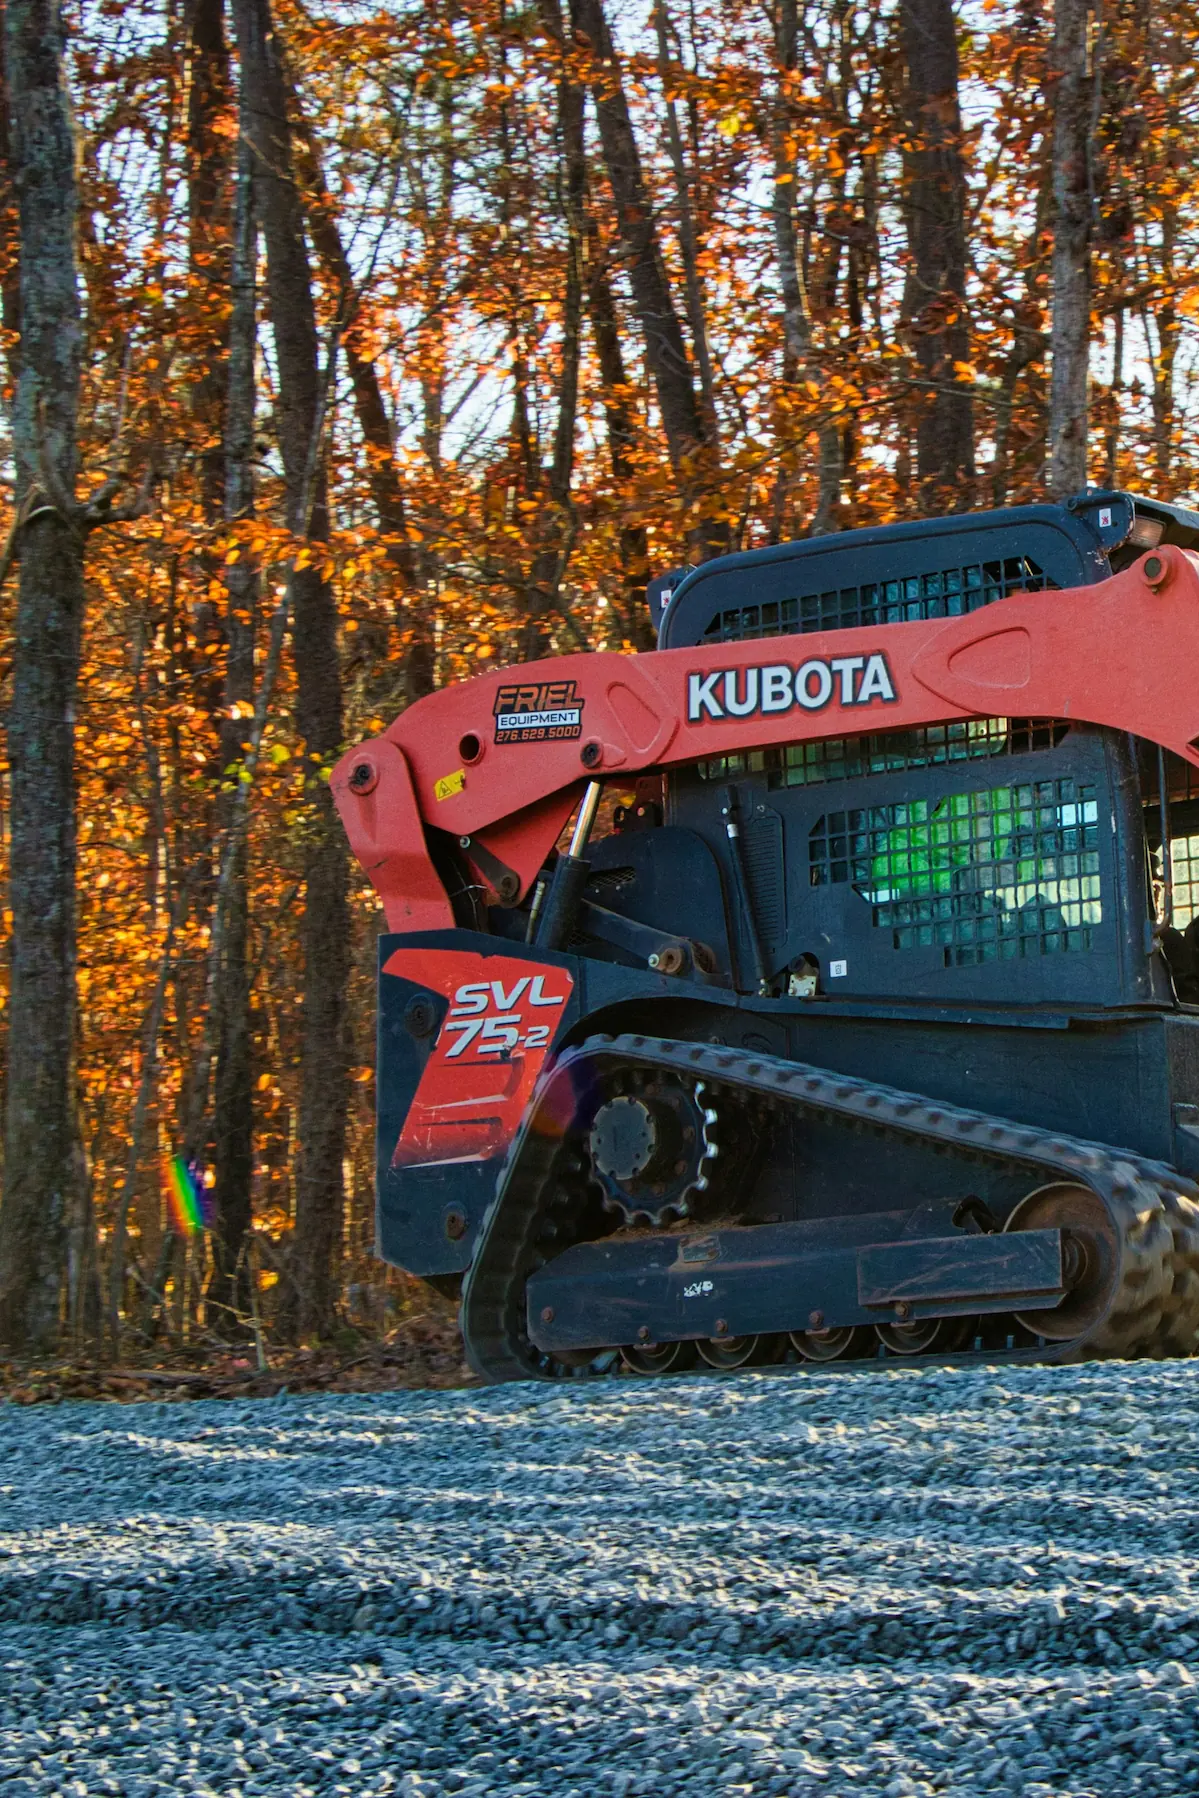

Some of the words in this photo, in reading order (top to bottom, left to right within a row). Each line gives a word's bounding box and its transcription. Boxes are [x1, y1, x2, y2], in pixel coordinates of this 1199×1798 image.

[495, 684, 583, 713] FRIEL
[688, 654, 895, 720] KUBOTA
[497, 726, 580, 741] 276.629.5000
[500, 712, 577, 726] EQUIPMENT
[450, 975, 564, 1017] SVL
[445, 1014, 550, 1057] 75-2
